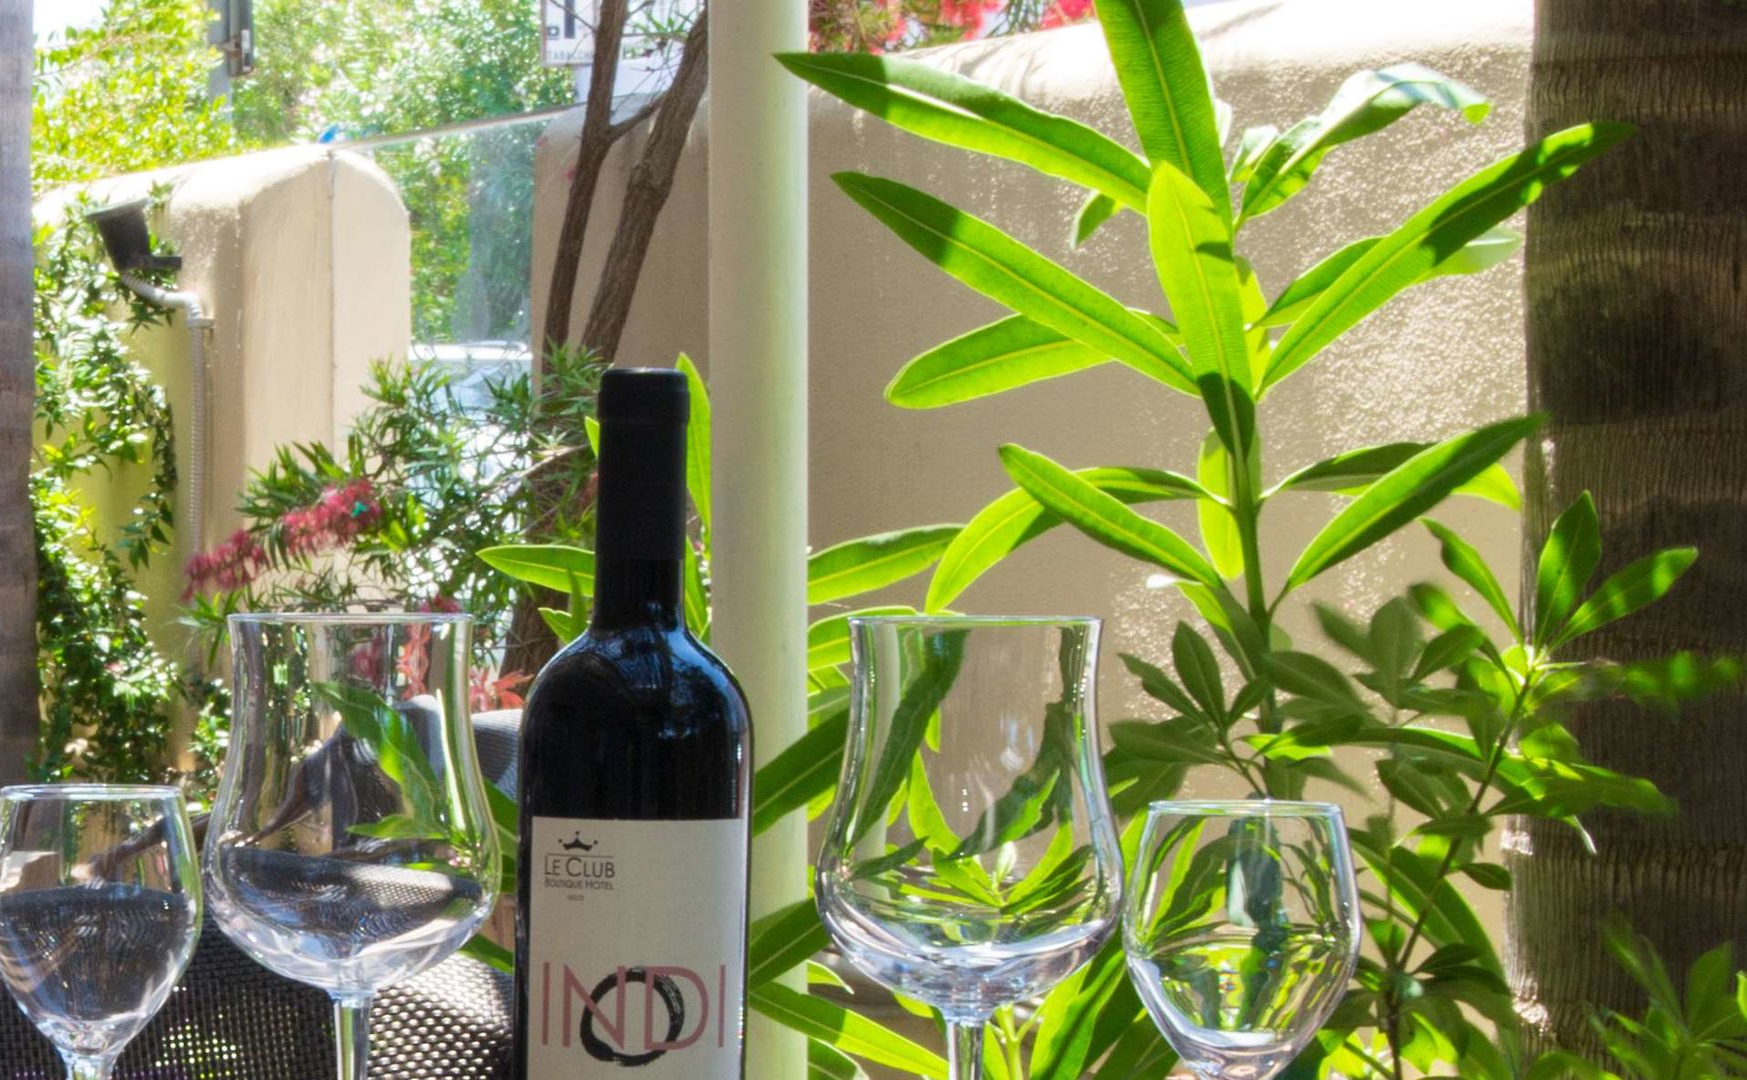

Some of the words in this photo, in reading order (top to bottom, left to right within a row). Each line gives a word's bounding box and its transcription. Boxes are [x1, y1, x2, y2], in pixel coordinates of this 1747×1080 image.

[545, 855, 561, 876] LE
[566, 856, 616, 878] CLUB
[545, 877, 582, 889] BOUTIQUE
[585, 879, 614, 891] HOTEL
